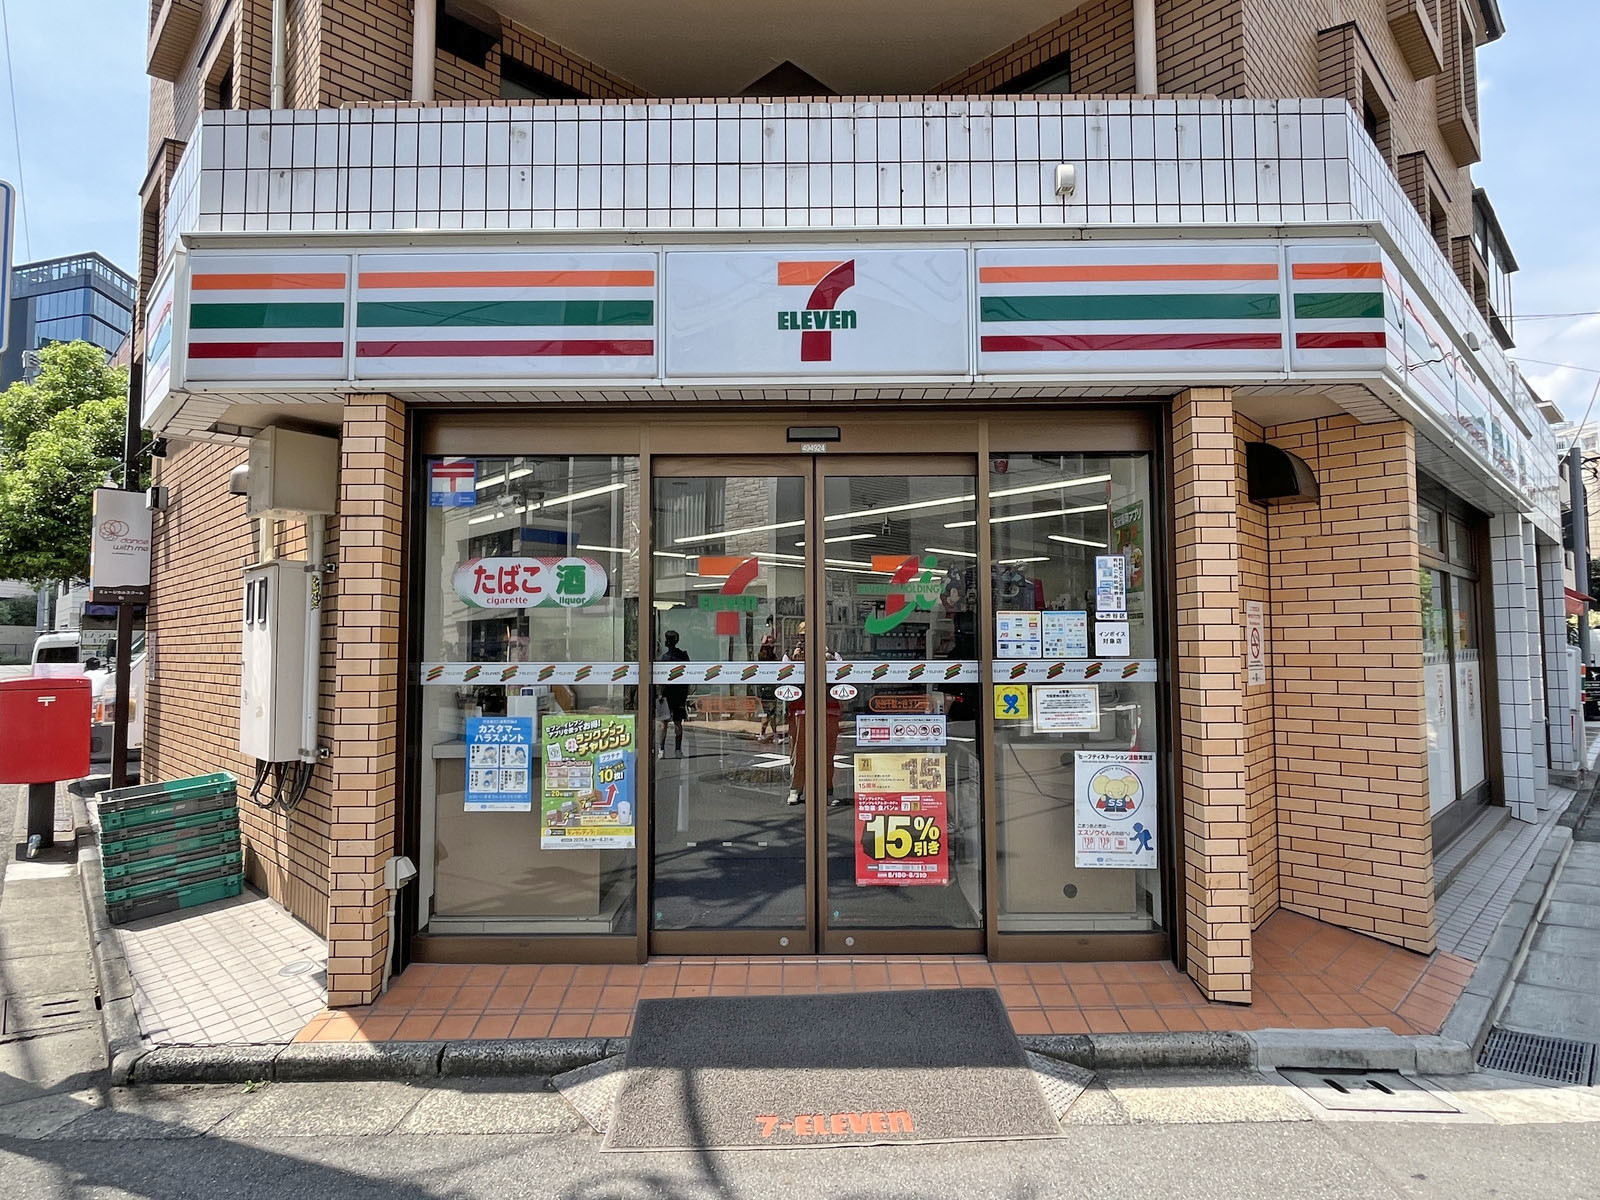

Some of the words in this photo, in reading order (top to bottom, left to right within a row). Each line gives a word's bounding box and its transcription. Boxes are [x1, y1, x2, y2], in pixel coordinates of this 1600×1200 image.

[778, 259, 855, 361] 7
[113, 544, 134, 552] with
[473, 563, 542, 595] たばこ
[556, 565, 587, 595] 酒
[486, 596, 529, 606] cigarette
[558, 596, 587, 606] liquor
[478, 724, 521, 733] カスタマー
[474, 734, 524, 743] ハラスメント
[578, 733, 631, 755] チャレンジ
[1108, 799, 1123, 807] SS
[914, 841, 940, 857] 引き
